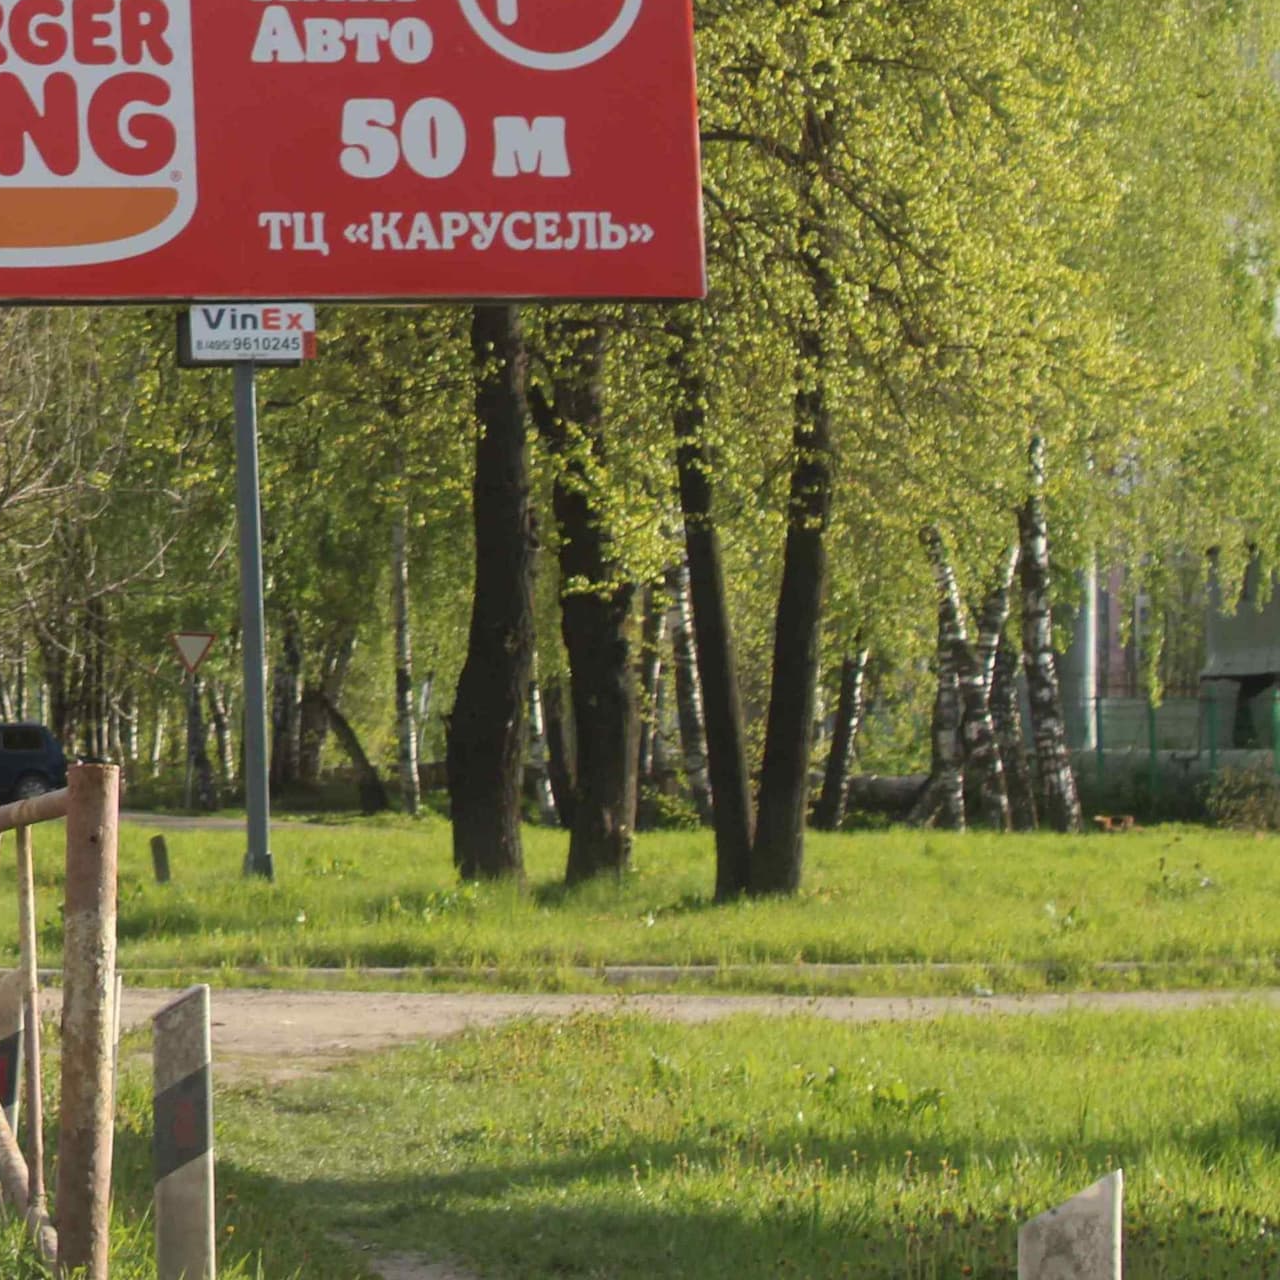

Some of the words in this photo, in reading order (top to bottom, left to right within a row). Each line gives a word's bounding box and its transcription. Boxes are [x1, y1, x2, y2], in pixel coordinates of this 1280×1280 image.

[251, 5, 433, 63] Авто
[339, 97, 467, 179] 50
[492, 116, 572, 177] м
[258, 211, 329, 256] ТЦ
[343, 211, 655, 251] «КАРУСЕЛЬ»
[202, 308, 304, 330] VinEx
